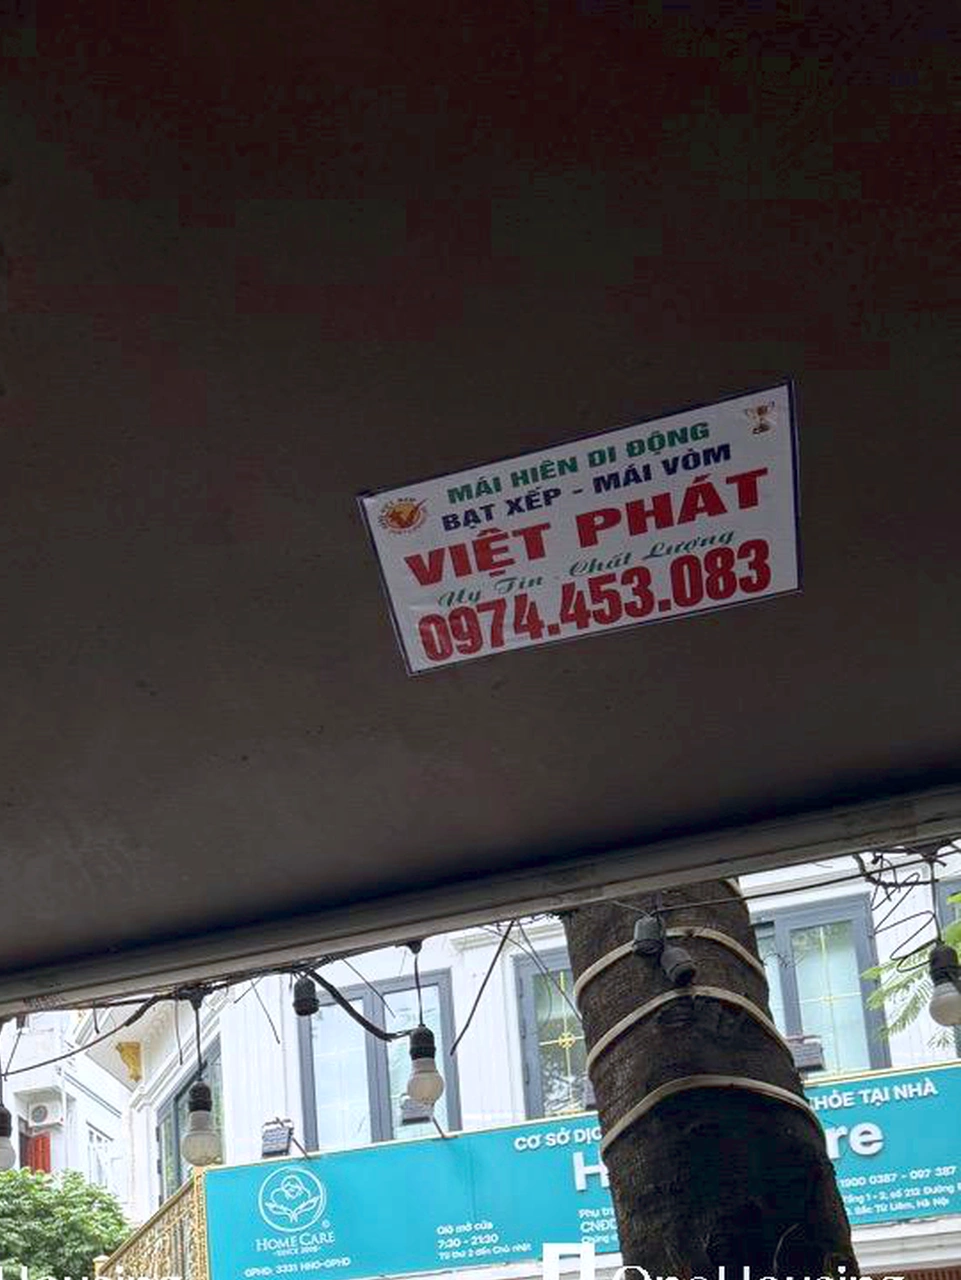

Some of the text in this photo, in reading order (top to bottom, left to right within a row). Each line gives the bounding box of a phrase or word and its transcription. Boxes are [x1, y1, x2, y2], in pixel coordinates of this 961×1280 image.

[442, 503, 496, 531] BẠT
[506, 485, 562, 516] XẾP
[593, 463, 652, 494] MÁI
[661, 443, 732, 476] VÒM
[447, 421, 710, 504] MÁI HIÊN DI ĐỘNG
[404, 467, 768, 586] VIỆT PHÁT
[419, 538, 772, 662] 0974.453.083
[438, 587, 481, 607] Uy
[569, 552, 632, 577] Chất
[642, 530, 734, 560] Lượng
[858, 1086, 890, 1107] TẠI
[893, 1077, 939, 1100] NHÀ
[514, 1133, 542, 1150] CƠ
[545, 1127, 572, 1147] SỞ
[256, 1235, 298, 1252] HOME
[299, 1230, 336, 1247] CARE
